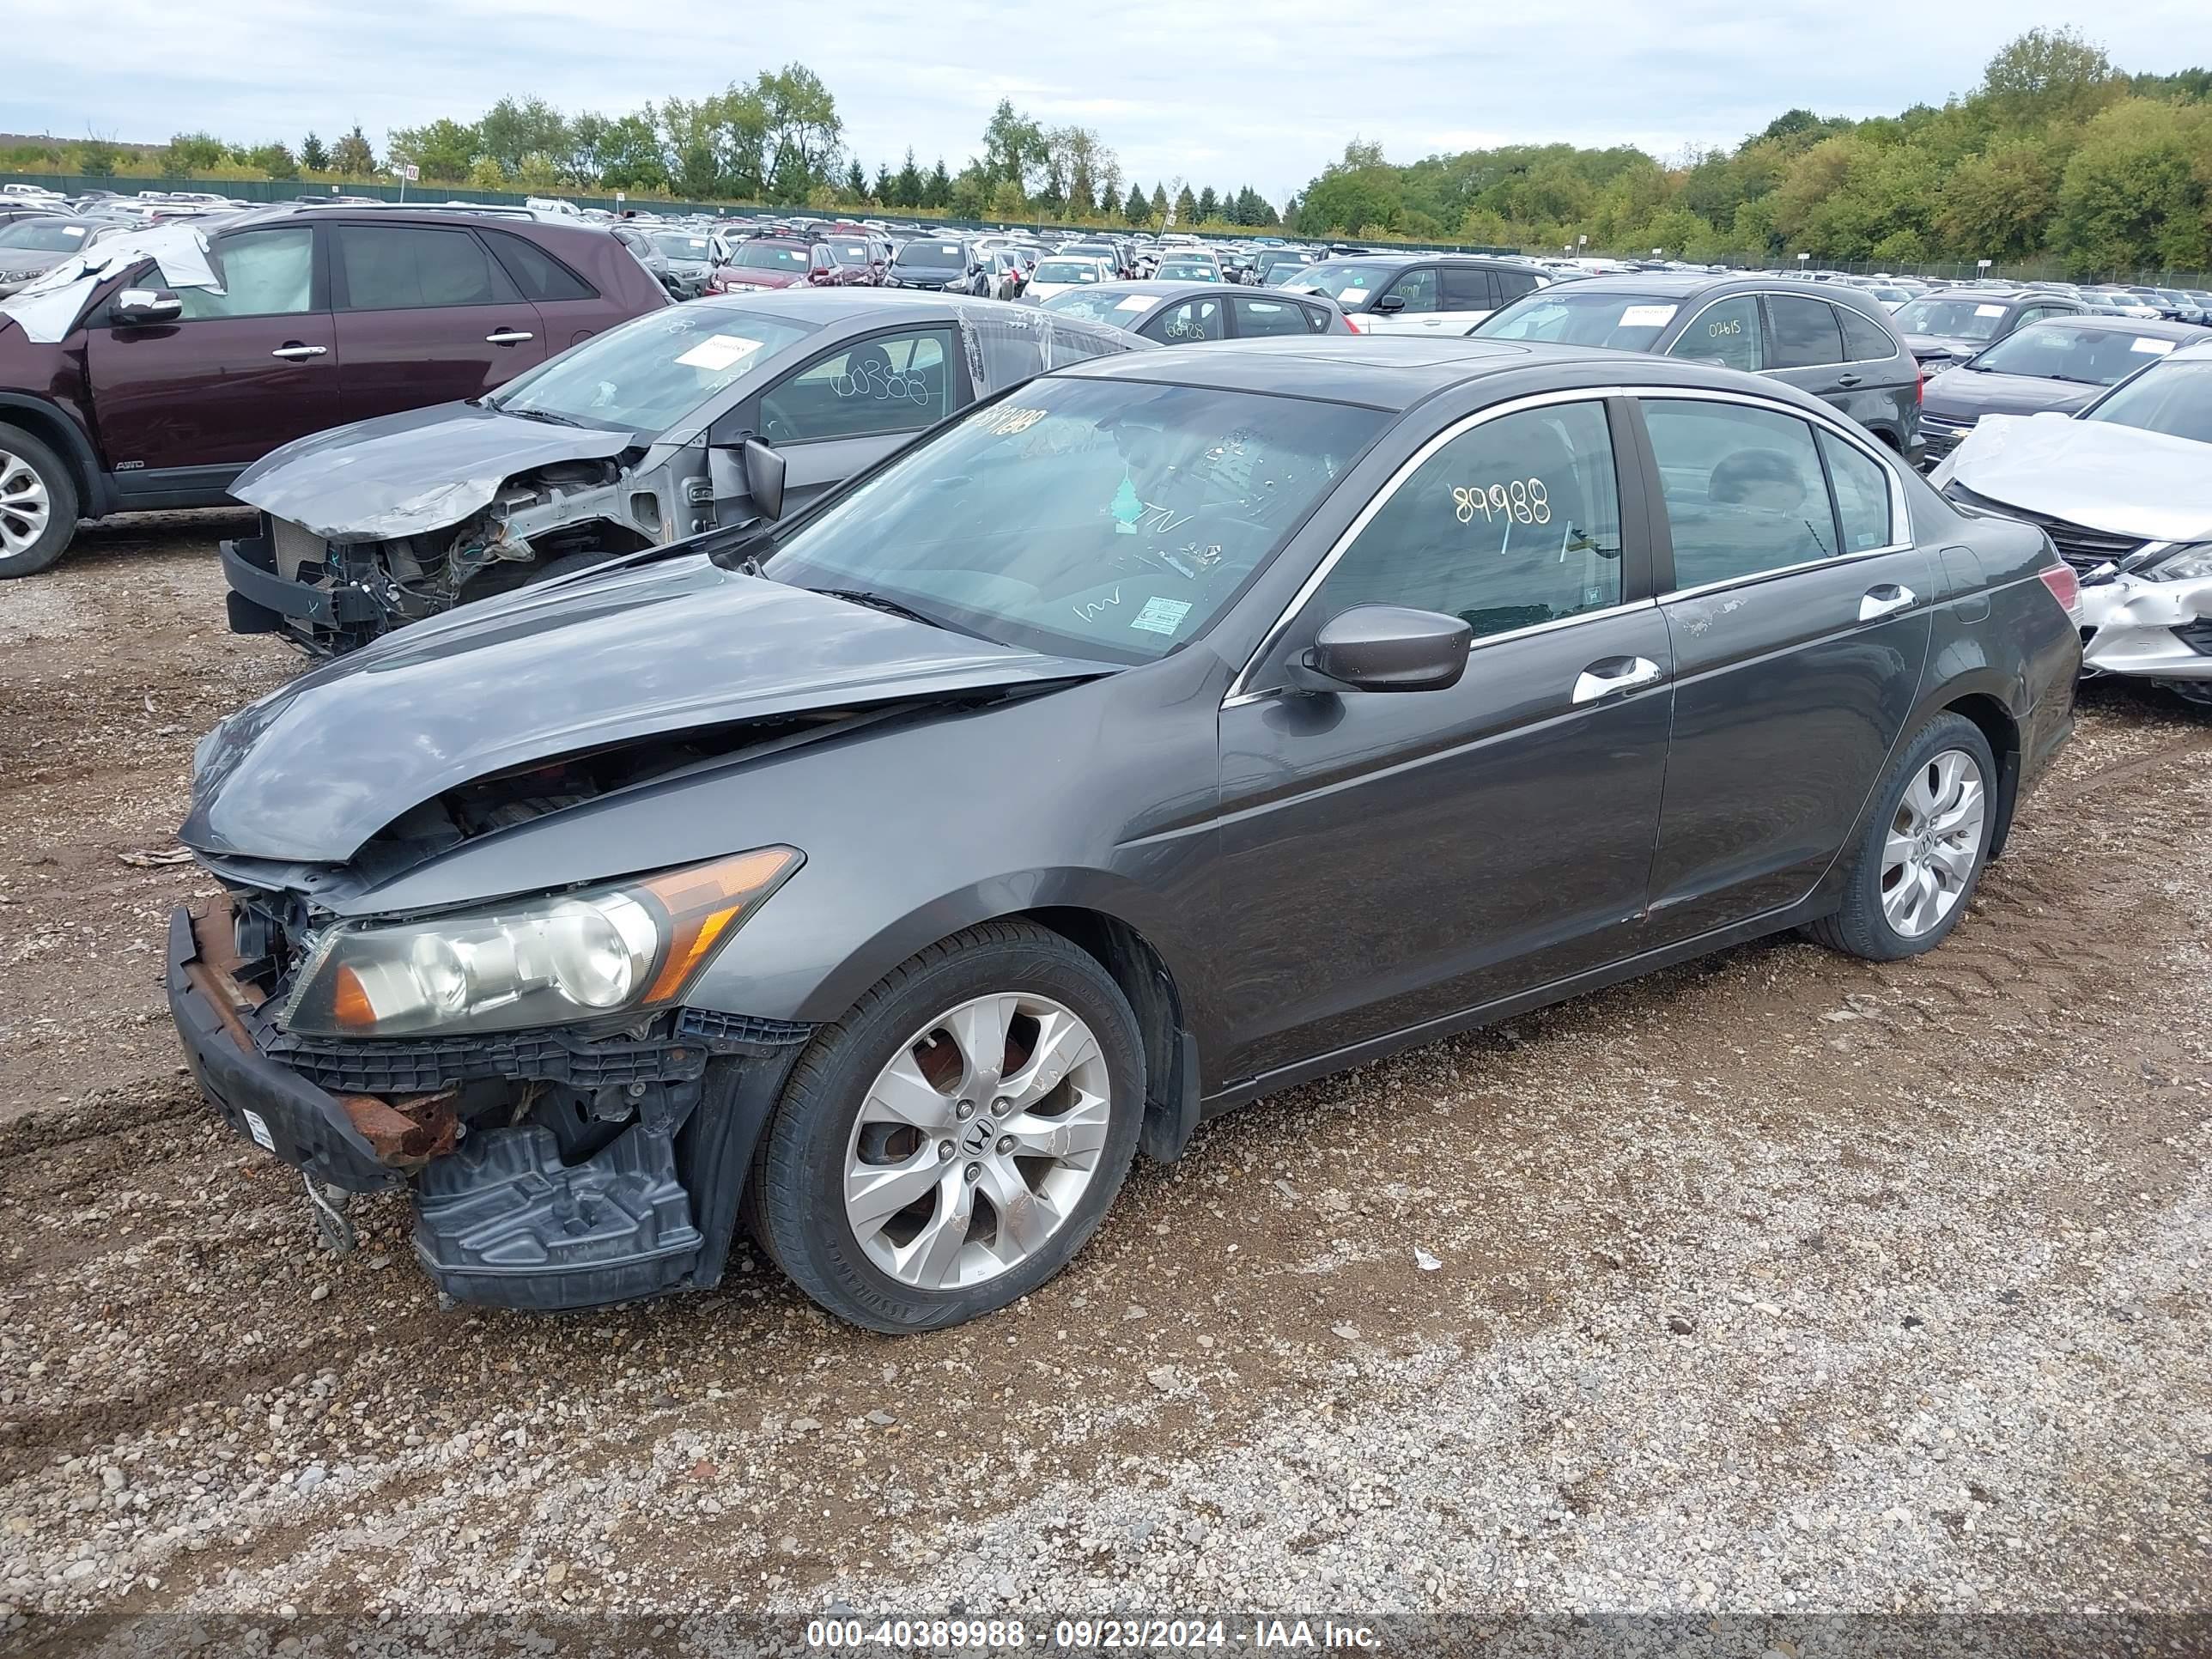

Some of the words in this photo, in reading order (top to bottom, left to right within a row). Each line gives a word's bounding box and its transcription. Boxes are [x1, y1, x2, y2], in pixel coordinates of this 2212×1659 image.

[1709, 319, 1741, 337] 02615
[115, 460, 145, 471] AWD
[1452, 477, 1551, 525] 89988
